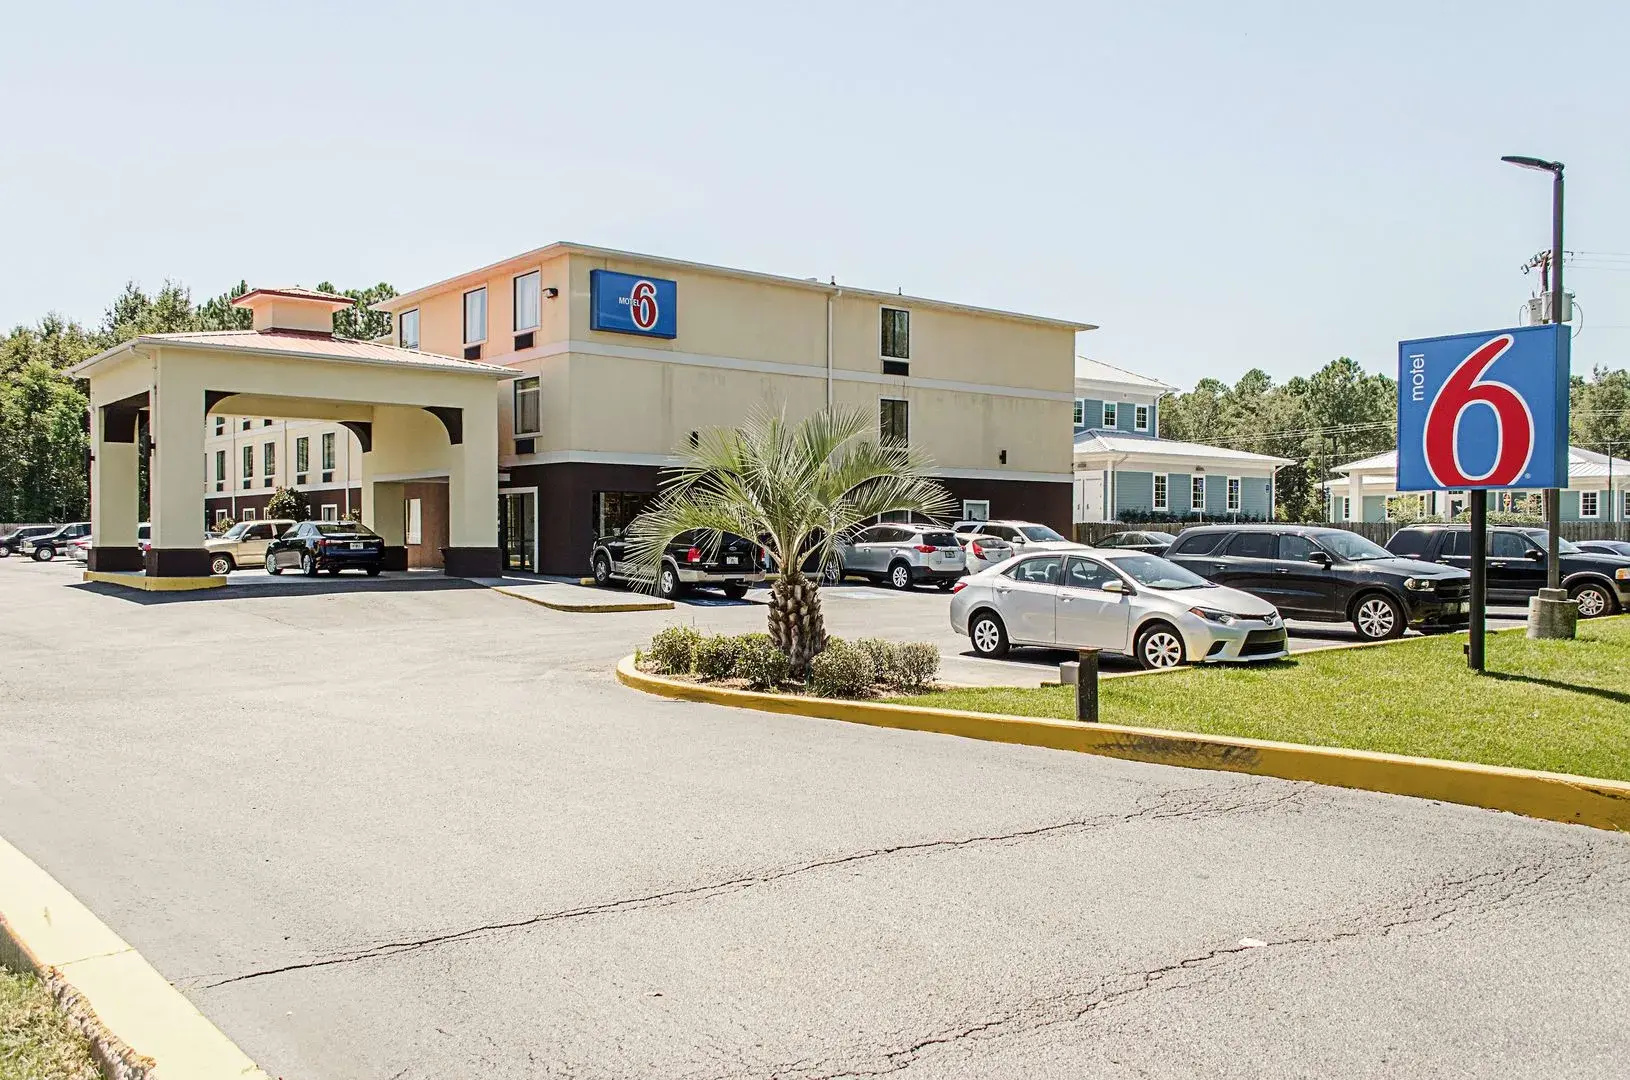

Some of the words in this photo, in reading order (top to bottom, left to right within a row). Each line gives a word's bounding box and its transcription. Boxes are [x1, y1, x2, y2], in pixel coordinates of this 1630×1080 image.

[618, 296, 640, 307] MOTEL
[630, 280, 659, 331] 6
[1409, 353, 1425, 402] motel
[1423, 333, 1535, 488] 6
